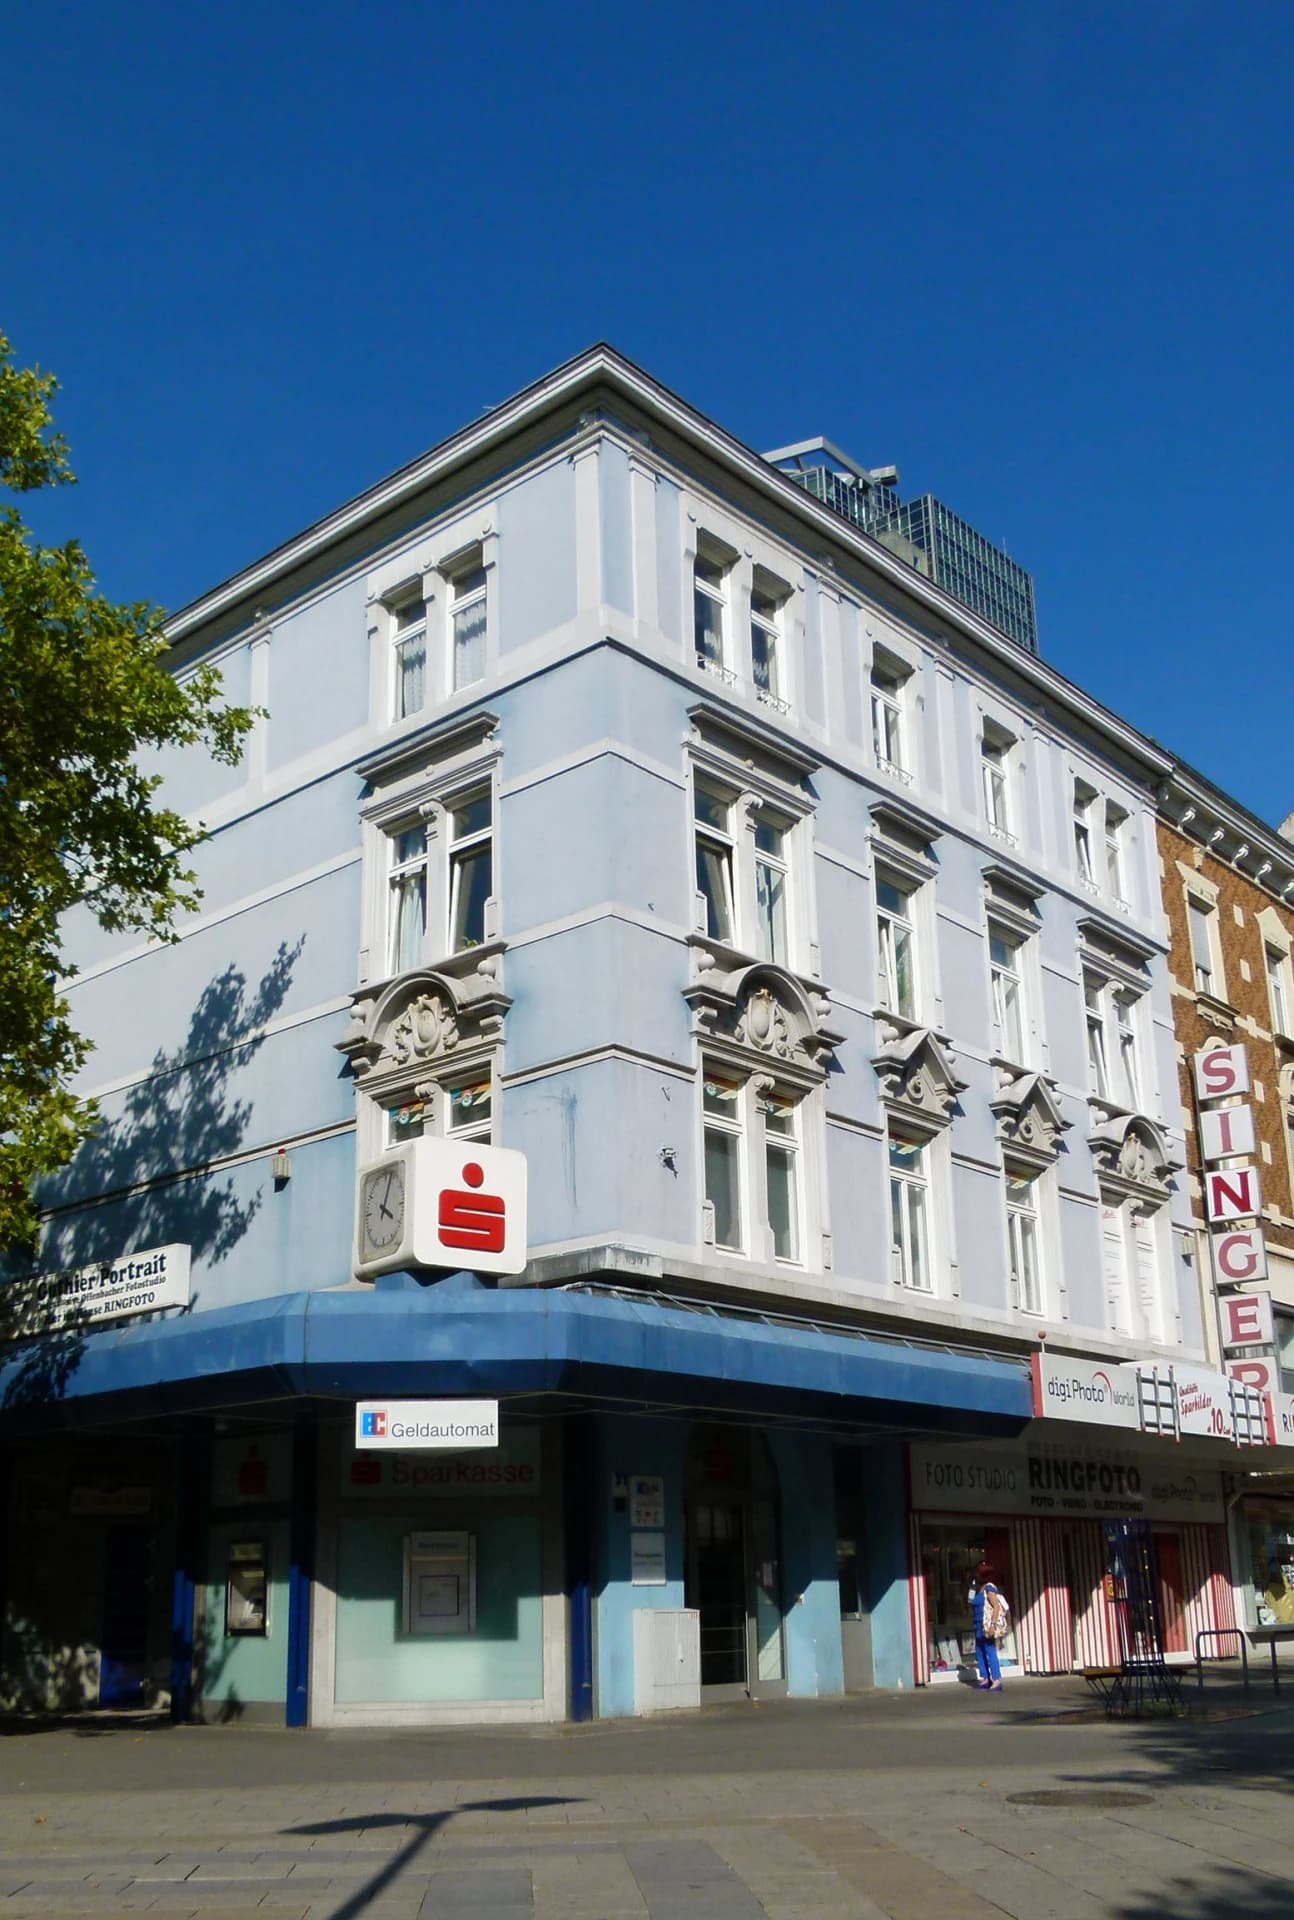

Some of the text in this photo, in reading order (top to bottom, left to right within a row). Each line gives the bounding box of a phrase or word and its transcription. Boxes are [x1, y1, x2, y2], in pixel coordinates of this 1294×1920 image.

[100, 1254, 167, 1287] Portrait
[125, 1275, 167, 1292] Fotostudio
[104, 1292, 155, 1313] RINGFOTO
[391, 1422, 495, 1439] Geldautomat
[1211, 1407, 1223, 1434] 10
[1282, 1413, 1294, 1433] RI
[391, 1459, 535, 1488] Sparkasse
[925, 1462, 1016, 1490] FOTO STUDIO
[1028, 1456, 1142, 1494] RINGFOTO
